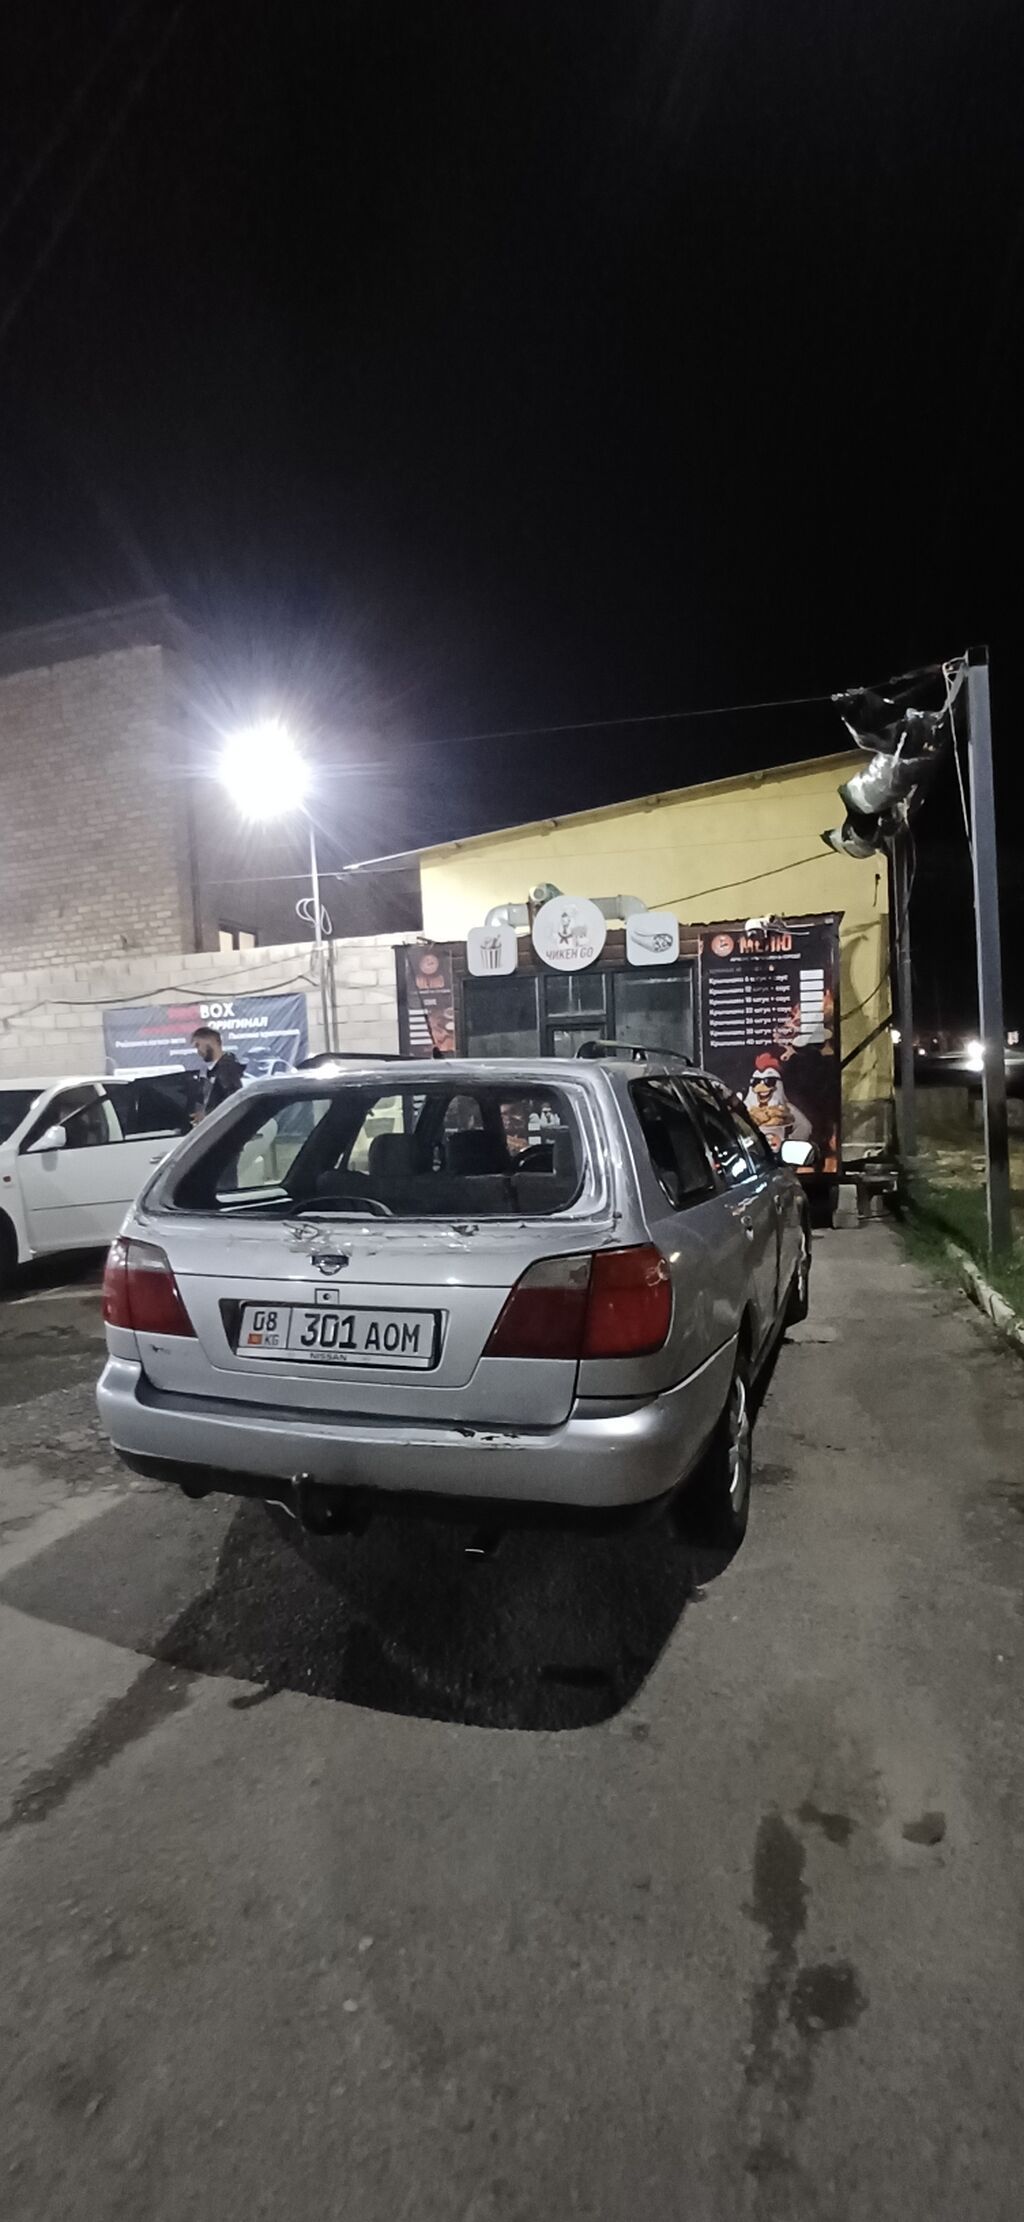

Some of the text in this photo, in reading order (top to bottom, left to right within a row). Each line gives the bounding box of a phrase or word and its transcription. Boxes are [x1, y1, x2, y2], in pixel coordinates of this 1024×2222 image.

[545, 947, 594, 960] ЧИКЕН GO
[200, 1002, 235, 1019] BOX
[252, 1311, 278, 1331] 08
[264, 1333, 279, 1346] KG
[300, 1312, 421, 1352] 301 AOM
[309, 1352, 347, 1361] NISSAN
